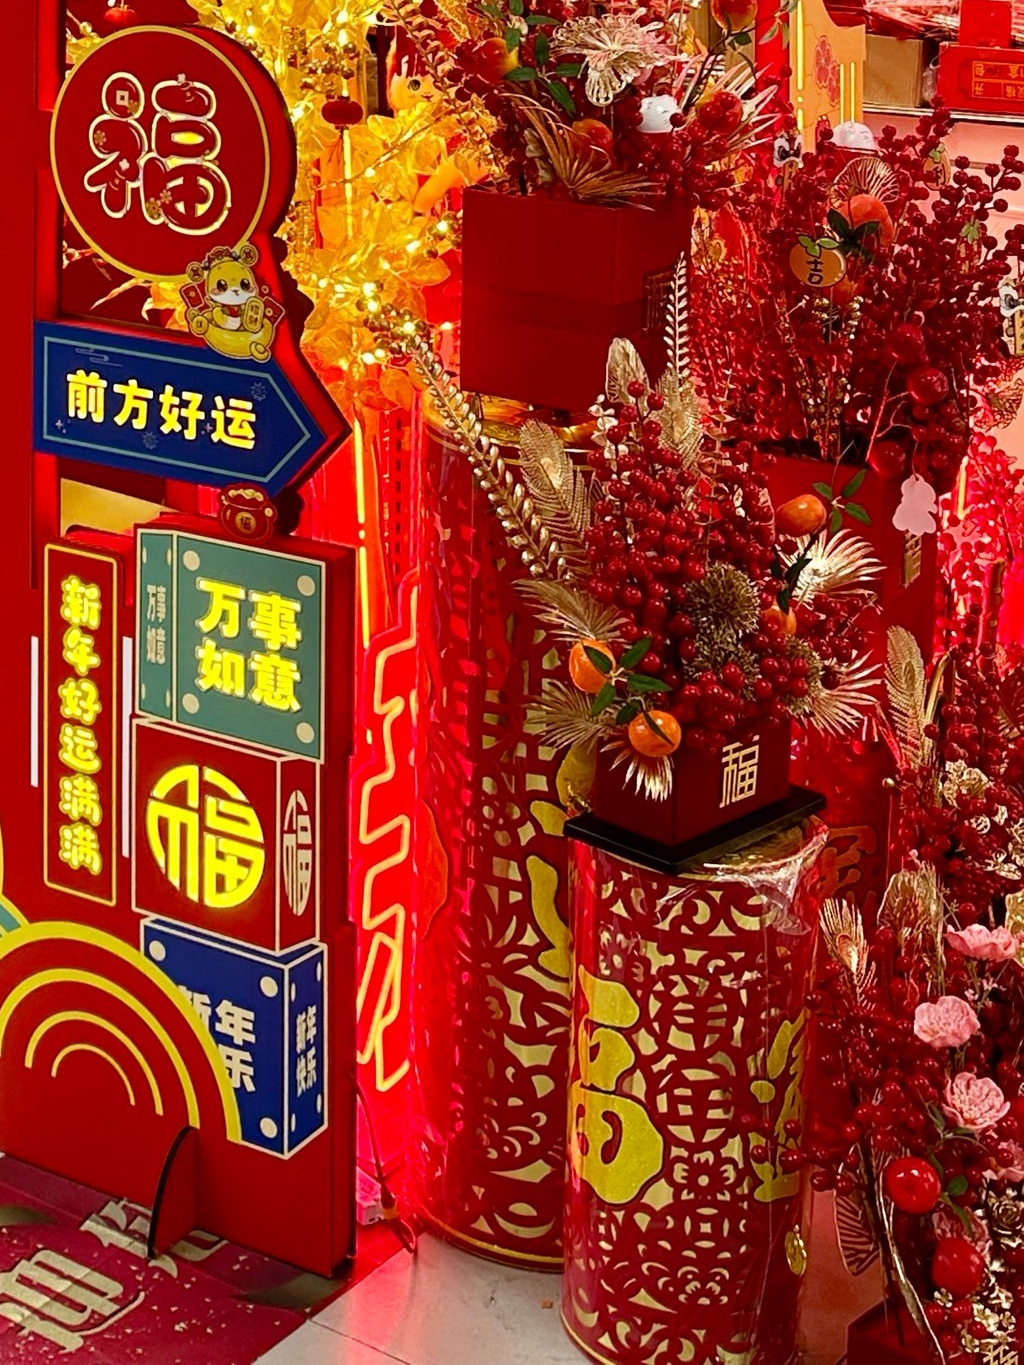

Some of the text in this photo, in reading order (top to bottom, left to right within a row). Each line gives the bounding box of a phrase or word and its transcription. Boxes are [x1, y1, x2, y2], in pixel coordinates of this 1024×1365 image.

[84, 71, 233, 237] 福
[806, 257, 824, 285] 吉
[66, 367, 258, 451] 前方好运
[196, 577, 302, 651] 万事
[196, 639, 302, 713] 如意
[59, 575, 102, 875] 新年好运满满
[718, 735, 760, 810] 福
[146, 765, 266, 909] 福
[283, 790, 312, 916] 福
